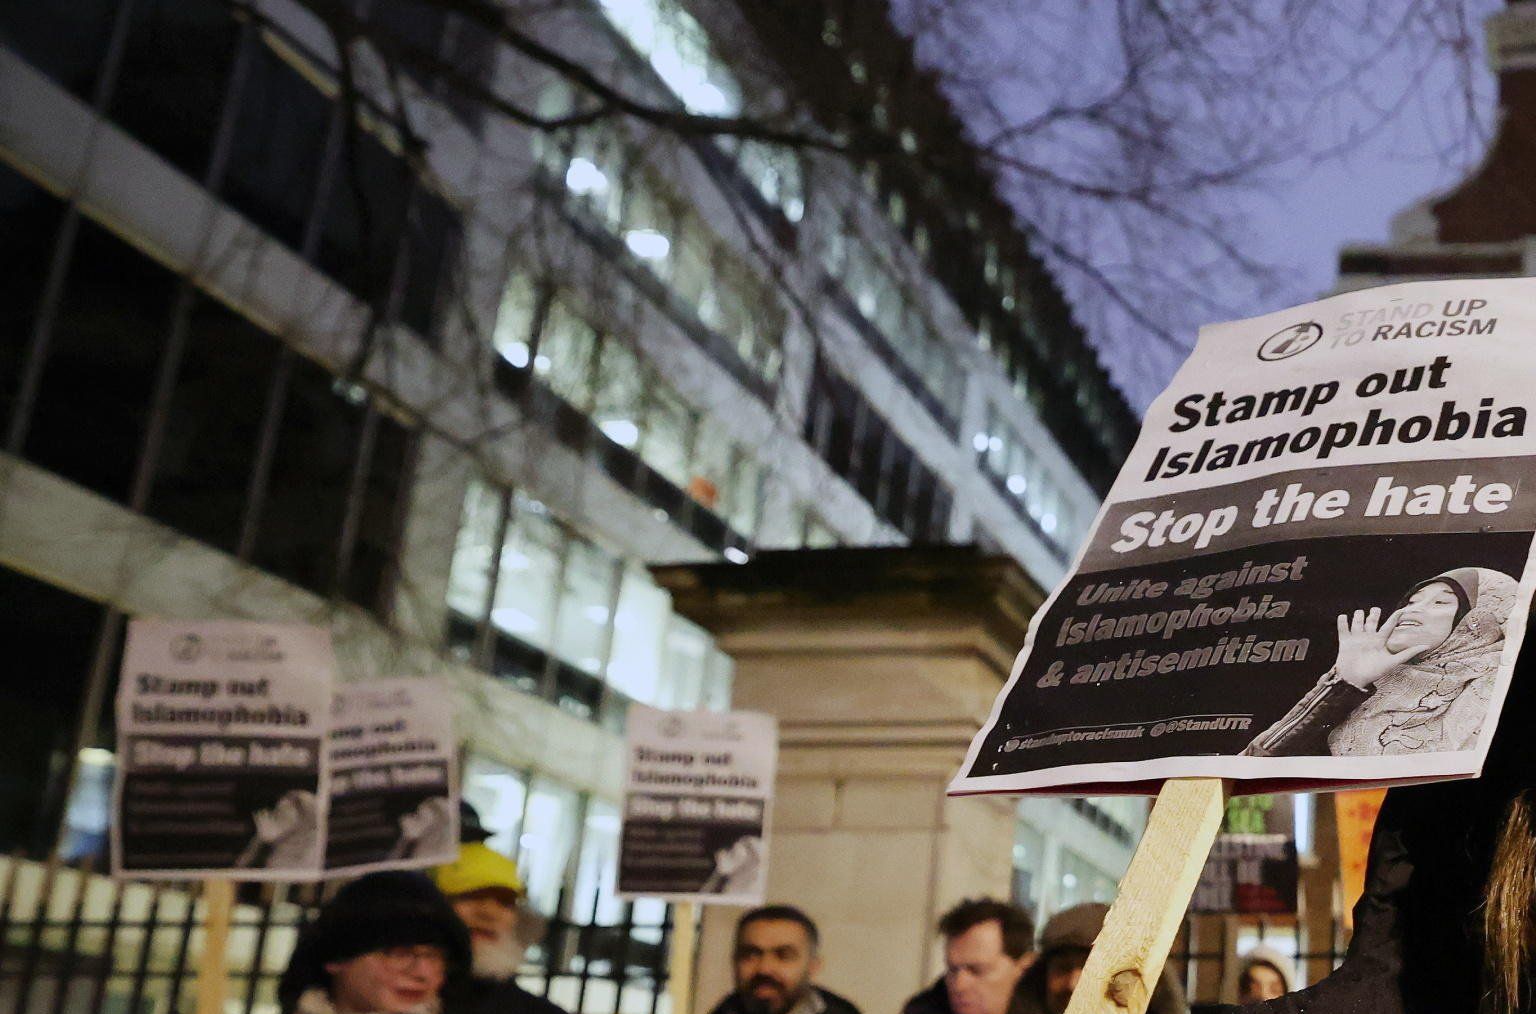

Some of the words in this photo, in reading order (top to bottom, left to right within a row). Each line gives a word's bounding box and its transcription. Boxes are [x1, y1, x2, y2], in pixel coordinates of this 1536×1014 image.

[1330, 329, 1366, 350] TO
[1371, 317, 1498, 342] RACISM
[1335, 302, 1434, 331] STAND
[1441, 299, 1488, 318] UP
[1168, 381, 1340, 433] Stamp
[1355, 355, 1453, 398] out
[1143, 397, 1528, 482] Islamophobia
[1110, 503, 1239, 554] Stop
[1251, 483, 1350, 529] the
[1364, 474, 1513, 518] hate
[1075, 578, 1170, 607] Unite
[1173, 555, 1310, 600] against
[1055, 594, 1292, 648] Islamophobia
[1036, 659, 1066, 689] &
[1069, 634, 1312, 687] antisemitism
[1165, 716, 1253, 736] @StandUTR
